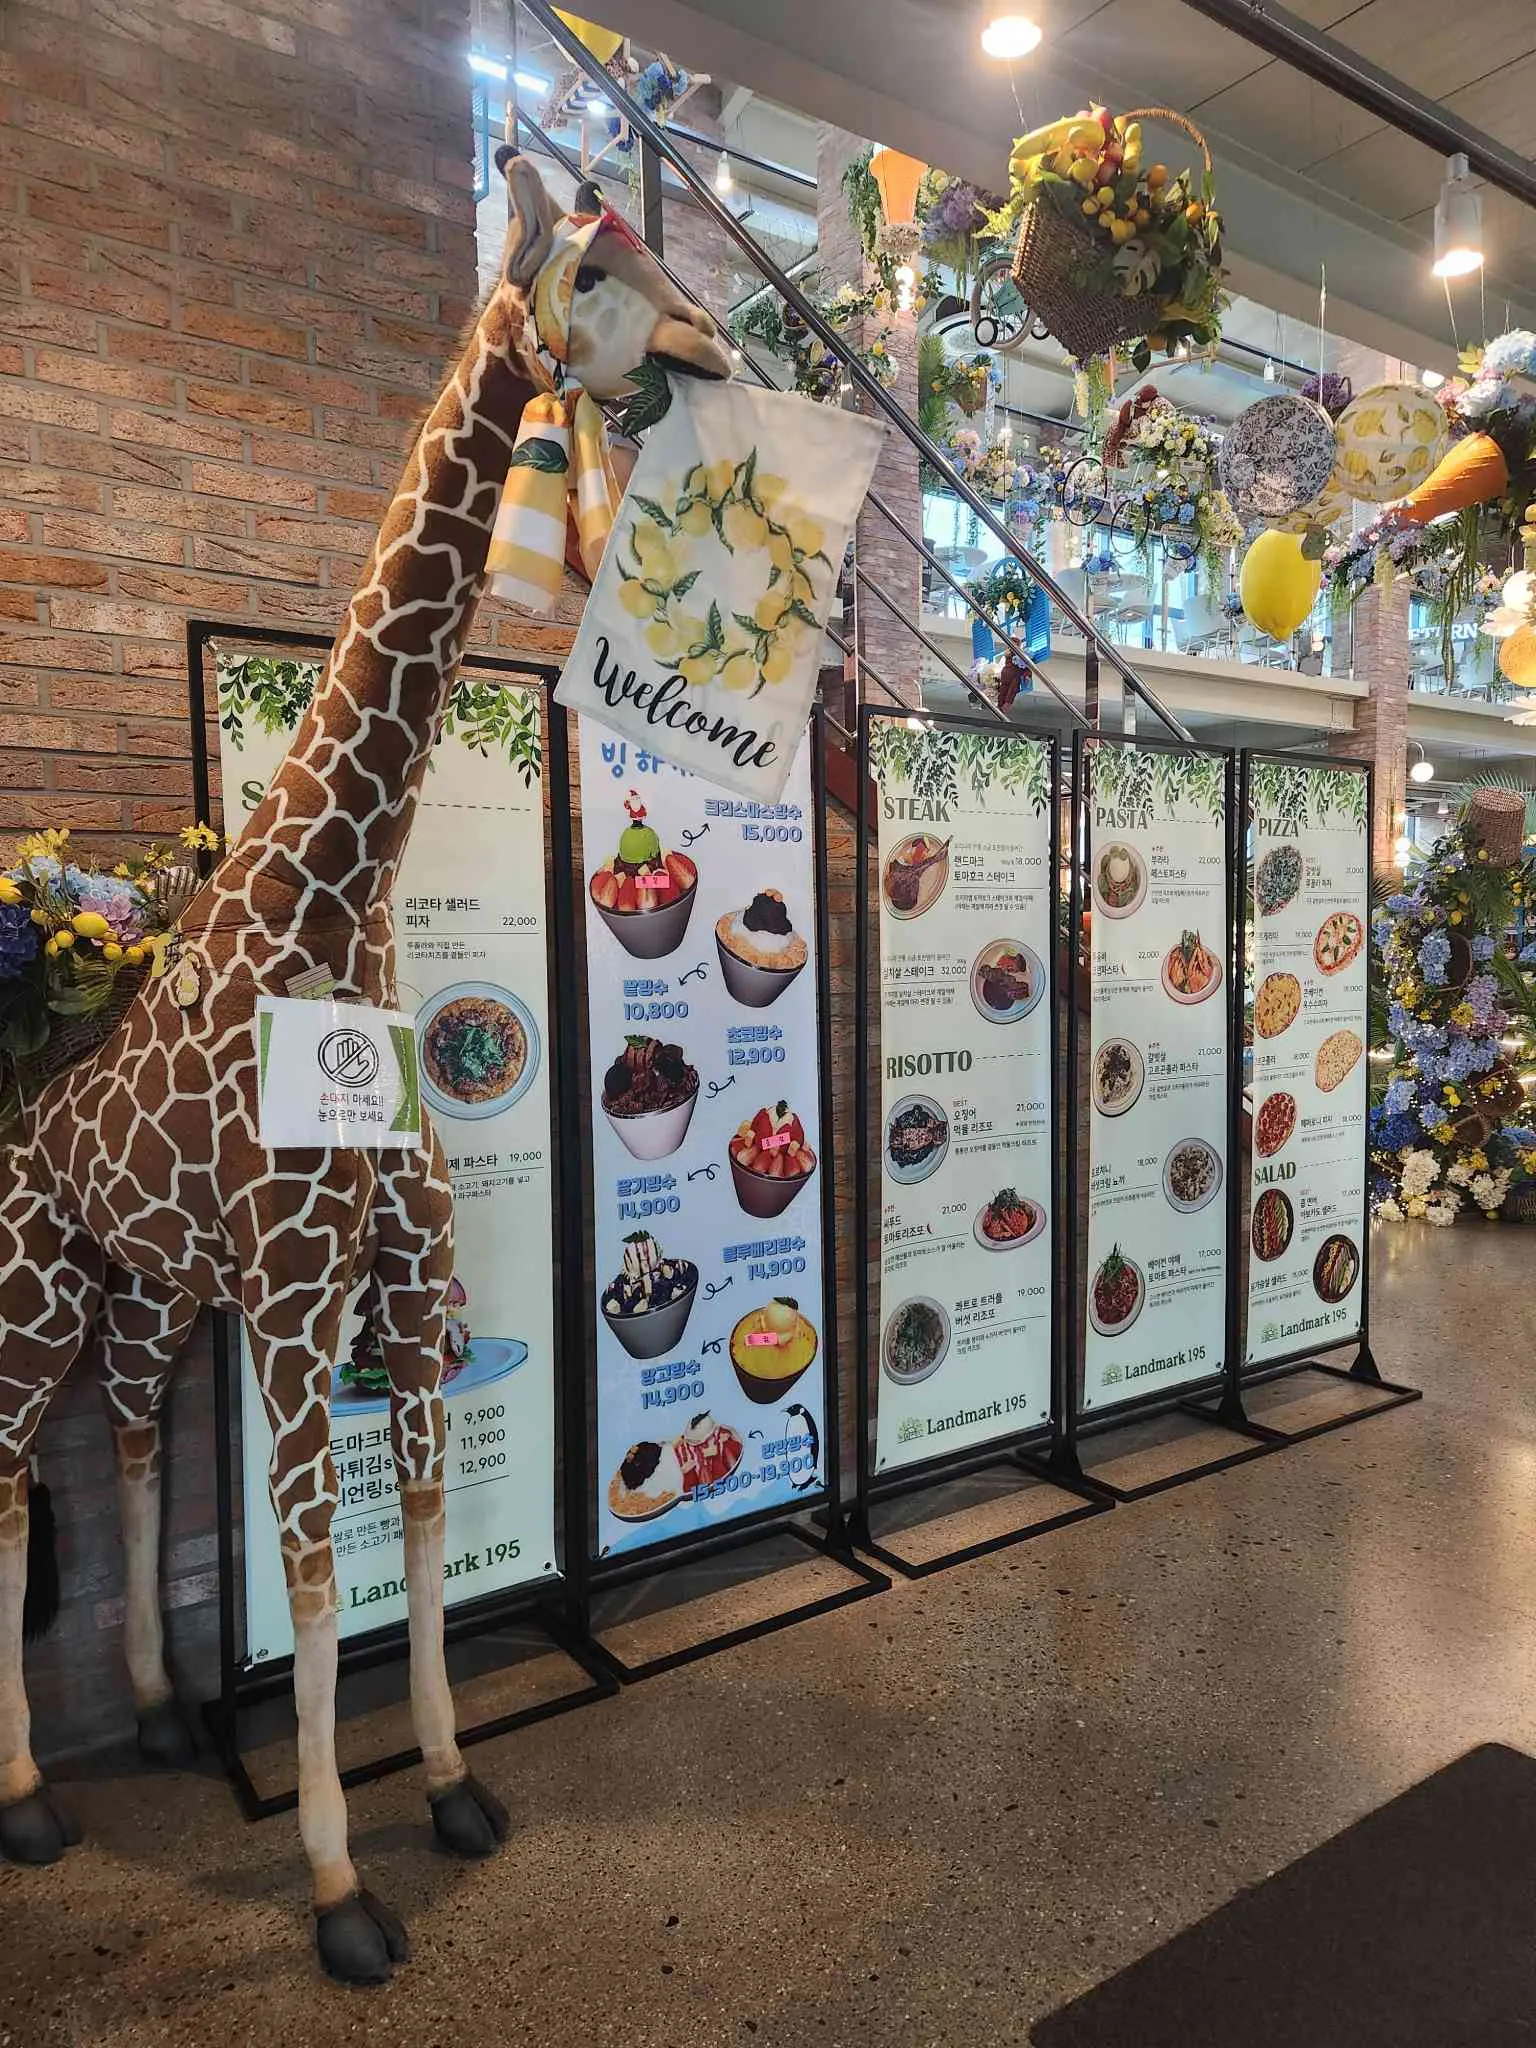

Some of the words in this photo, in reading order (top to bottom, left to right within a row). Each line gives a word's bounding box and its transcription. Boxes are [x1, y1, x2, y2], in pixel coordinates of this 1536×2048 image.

[593, 636, 778, 768] Welcome
[884, 796, 951, 822] STEAK
[1096, 807, 1148, 829] PASTA
[742, 824, 803, 842] 15,000
[1259, 818, 1298, 837] PIZZA
[954, 856, 984, 867] 랜드마크
[954, 871, 984, 882] 토마호크
[986, 871, 1015, 882] 스테이크
[406, 898, 441, 911] 리코타
[445, 897, 480, 911] 샐러드
[406, 915, 430, 928] 피자
[503, 917, 536, 927] 22,000
[904, 965, 934, 977] 스테이크
[623, 1001, 689, 1021] 10,800
[728, 1046, 786, 1066] 12,900
[887, 1050, 972, 1079] RISOTTO
[1180, 1062, 1199, 1073] 파스타
[318, 1109, 356, 1122] 눈으로만
[954, 1107, 976, 1121] 오징어
[1016, 1103, 1045, 1113] 21,000
[954, 1124, 969, 1136] 먹물
[971, 1121, 992, 1133] 리조또
[464, 1154, 497, 1168] 파스타
[509, 1151, 542, 1163] 19,000
[1255, 1162, 1296, 1186] SALAD
[617, 1173, 677, 1197] 딸기빙수
[617, 1195, 681, 1220] 14,900
[941, 1203, 967, 1215] 21,000
[747, 1256, 806, 1281] 14,900
[1149, 1270, 1166, 1282] 토마토
[1168, 1266, 1187, 1276] 파스타
[980, 1293, 1003, 1306] 트러플
[1018, 1287, 1045, 1296] 19,000
[955, 1313, 971, 1327] 버섯
[973, 1309, 995, 1322] 리조또
[1280, 1313, 1330, 1337] Landmark
[1333, 1308, 1347, 1322] 195
[1125, 1351, 1186, 1379] Landmark
[1188, 1346, 1206, 1362] 195
[641, 1360, 701, 1386] 망고빙수
[641, 1380, 705, 1409] 14,900
[464, 1405, 505, 1425] 9,900
[927, 1401, 1002, 1435] Landmark
[1005, 1394, 1027, 1413] 195
[460, 1429, 505, 1450] 11,900
[761, 1433, 815, 1460] 반반빙수
[460, 1452, 506, 1474] 12,900
[356, 1523, 378, 1537] 만든
[336, 1543, 358, 1557] 만든
[359, 1534, 391, 1551] 소고기
[486, 1539, 521, 1567] 195
